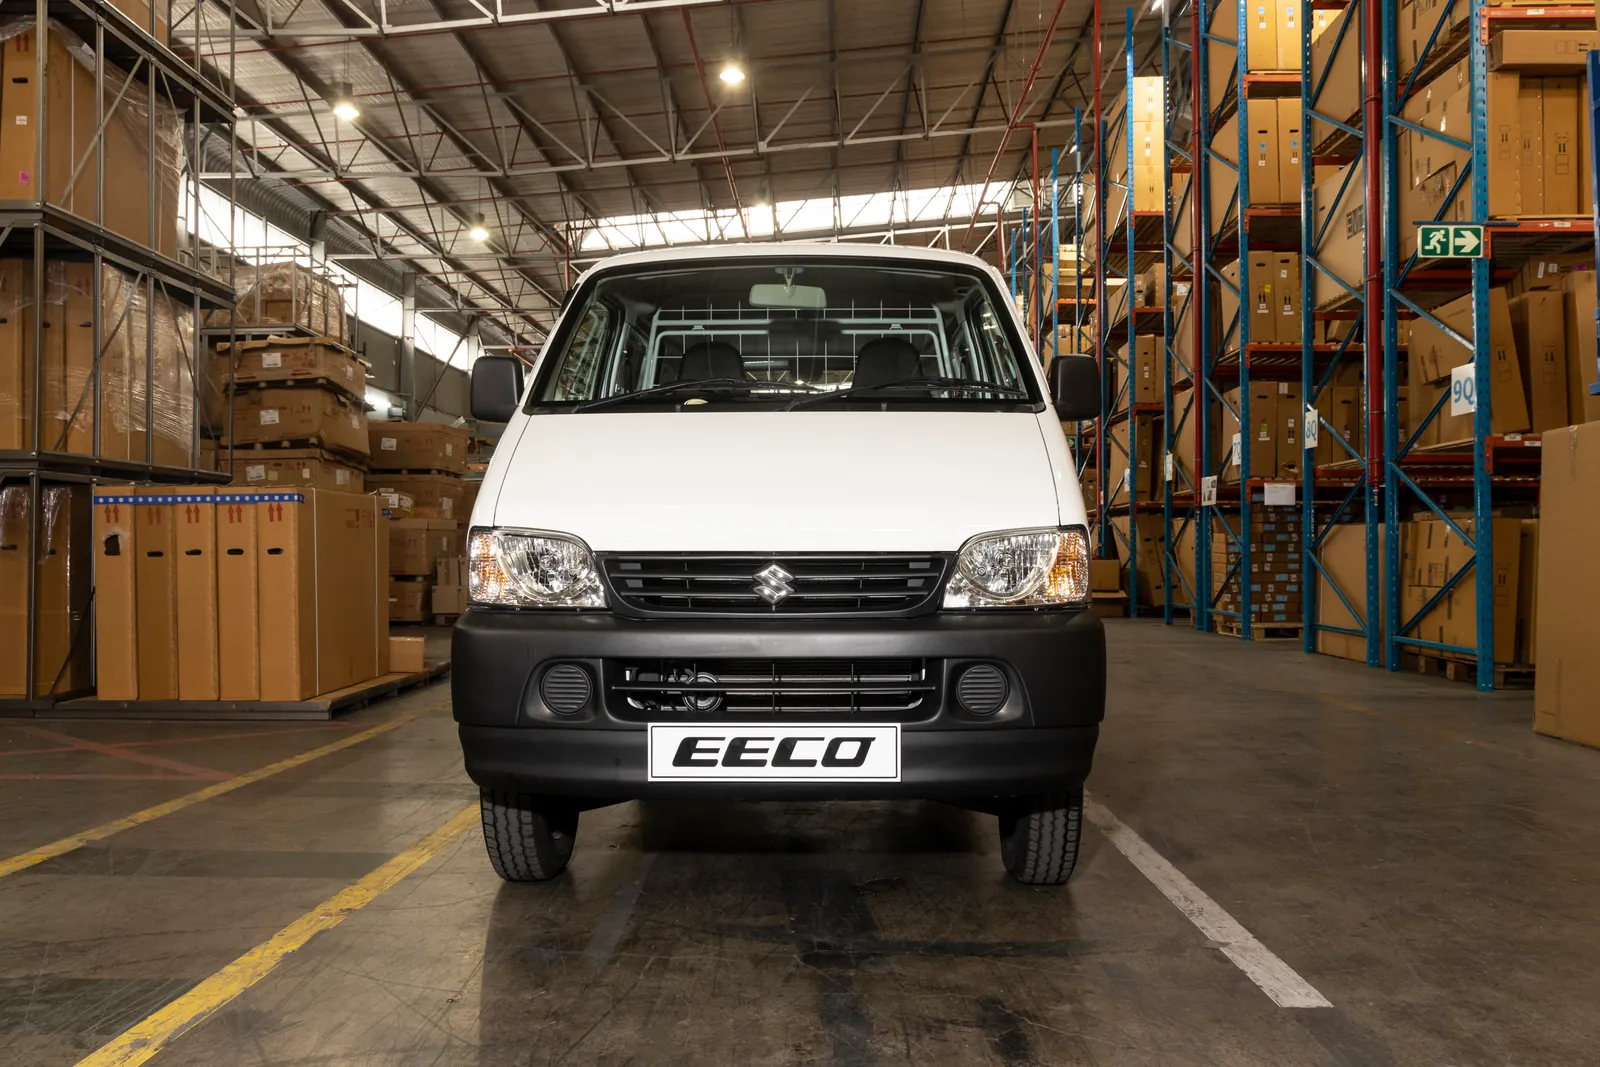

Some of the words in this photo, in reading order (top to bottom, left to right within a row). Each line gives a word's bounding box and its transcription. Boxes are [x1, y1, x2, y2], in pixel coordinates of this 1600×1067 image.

[1453, 377, 1475, 405] 9Q
[1306, 420, 1317, 441] 8Q
[672, 737, 876, 768] EECO
